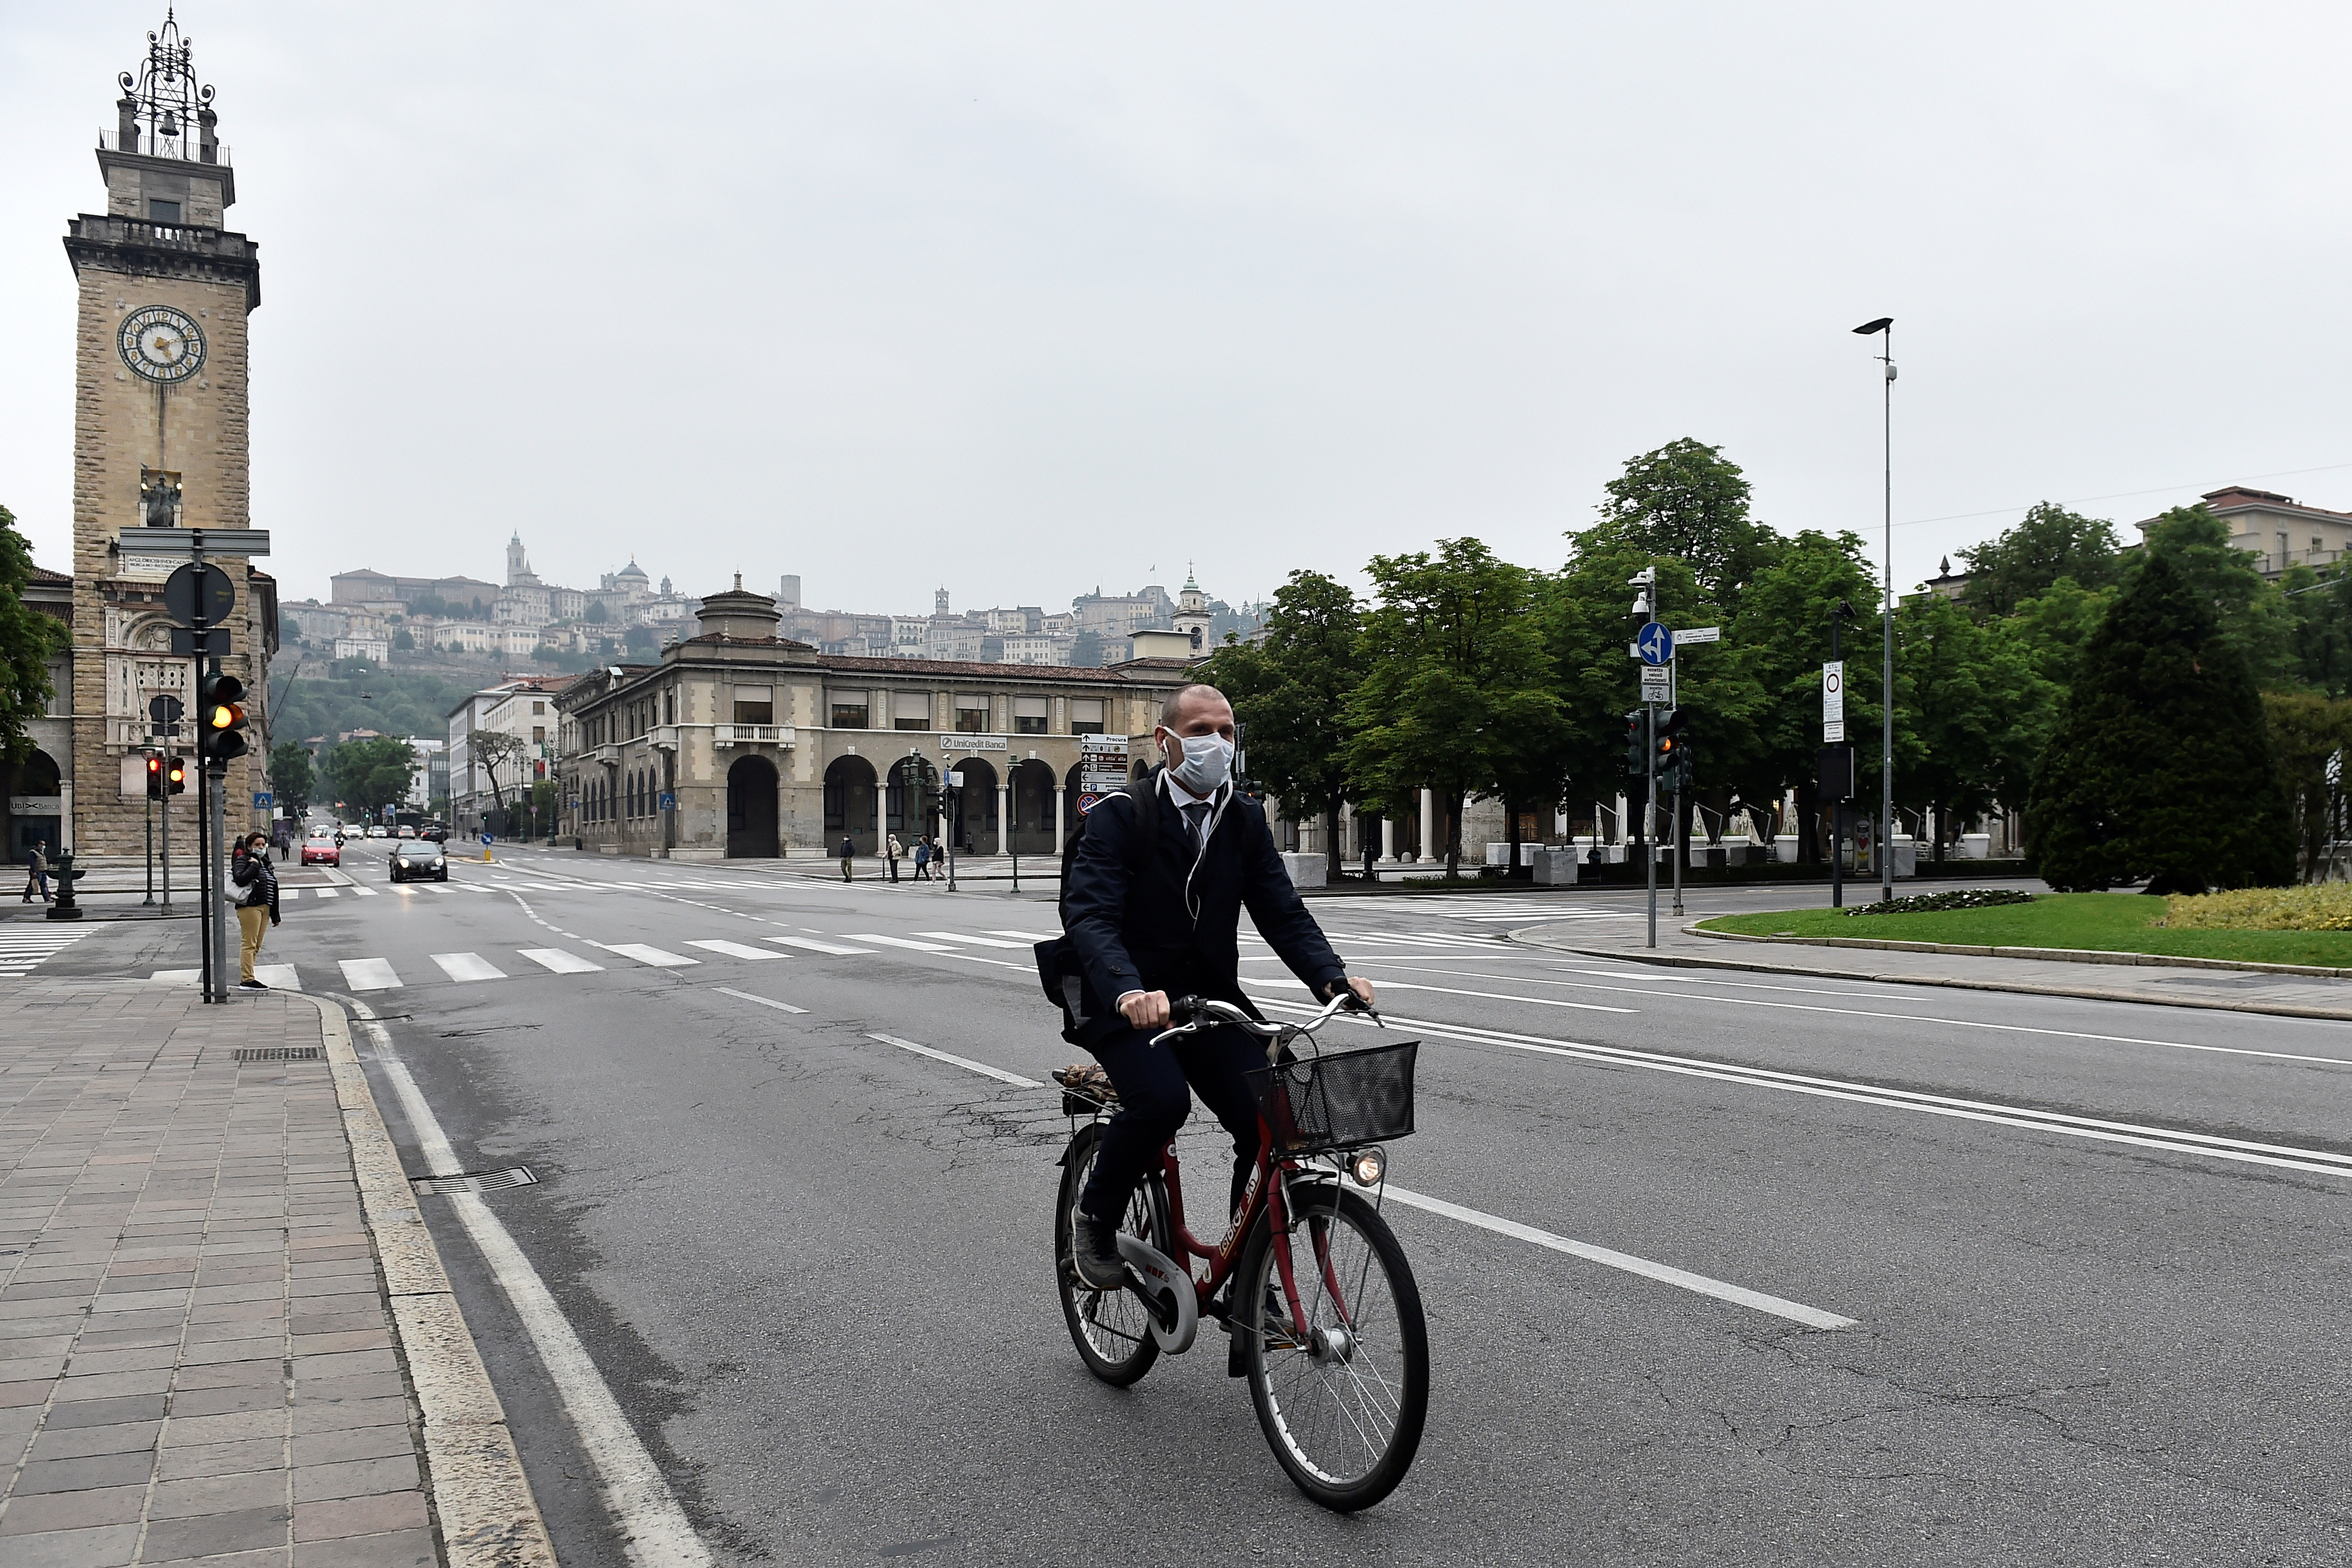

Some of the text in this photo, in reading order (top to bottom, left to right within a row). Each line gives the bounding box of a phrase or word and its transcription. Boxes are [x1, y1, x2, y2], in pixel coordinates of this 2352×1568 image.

[142, 313, 151, 323] 11
[156, 312, 168, 322] 12
[176, 317, 180, 328] 1
[129, 323, 140, 333] 10
[126, 337, 134, 346] 9
[131, 351, 137, 361] 8
[186, 358, 193, 366] 4
[143, 363, 150, 373] 7
[175, 366, 182, 376] 5
[158, 369, 166, 378] 6
[954, 739, 1006, 749] UniCredit Banca
